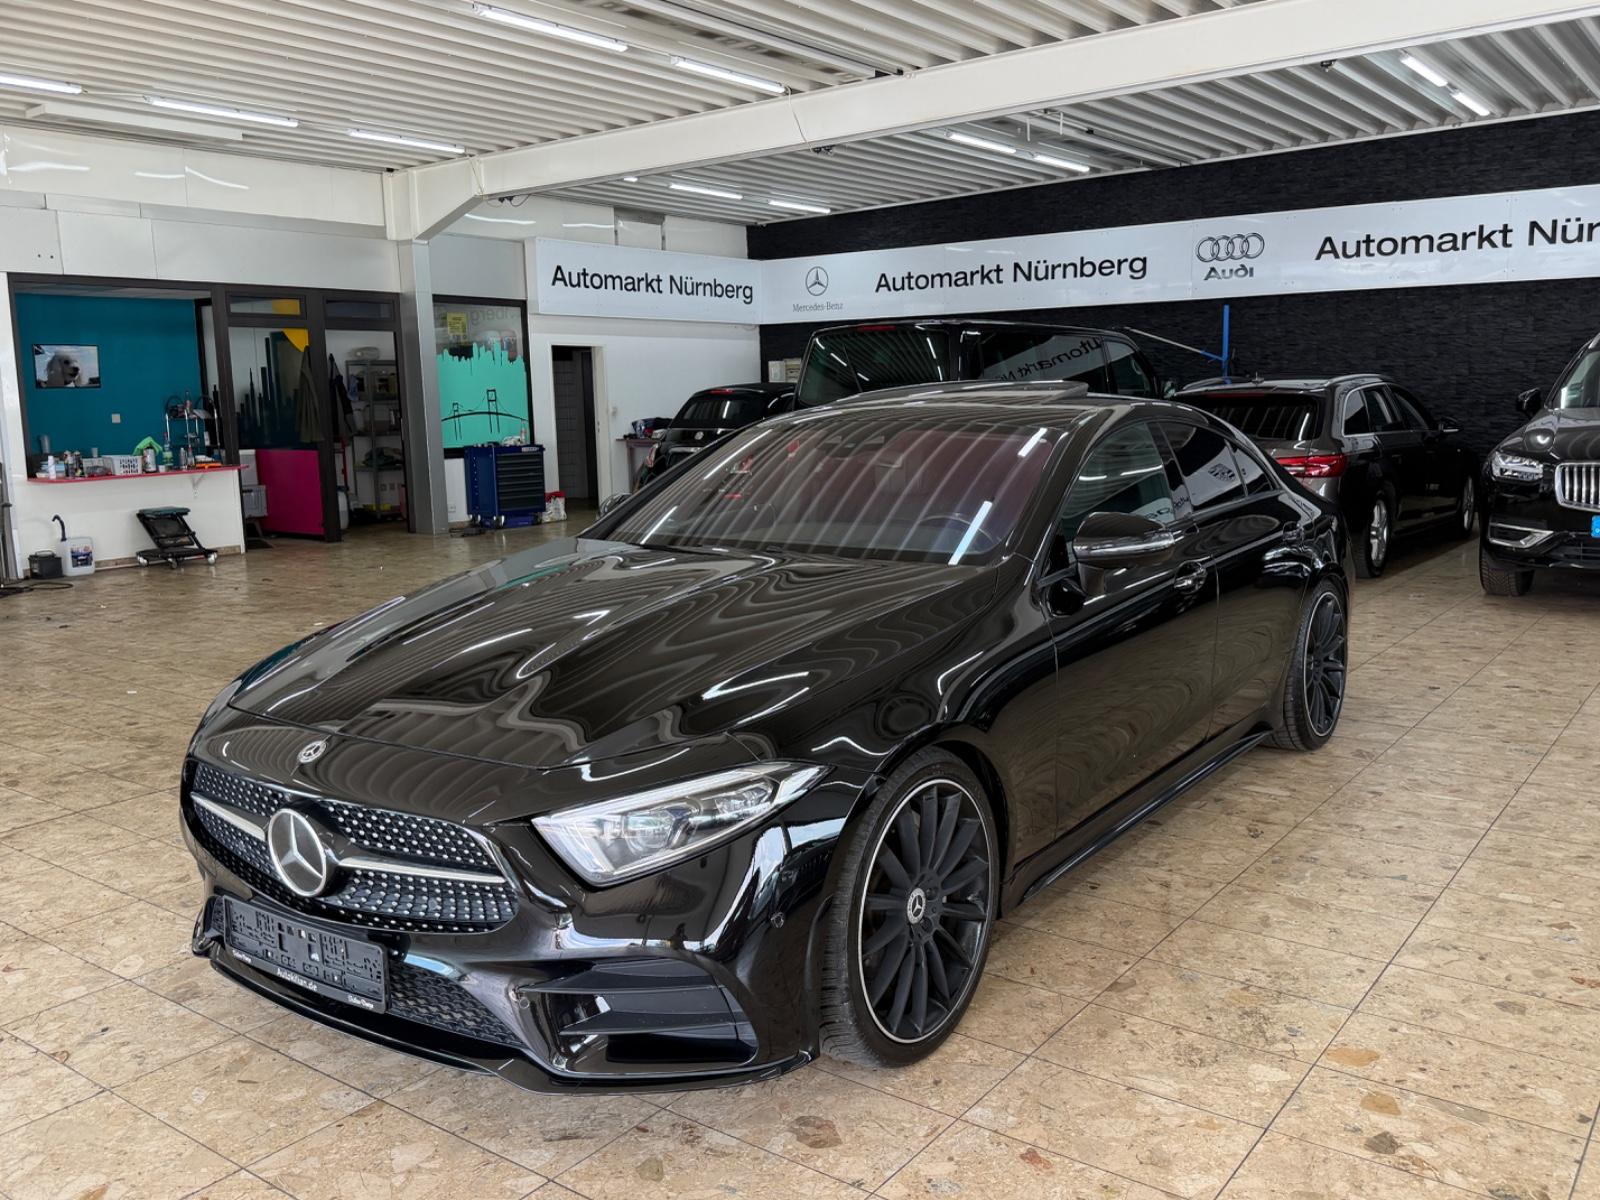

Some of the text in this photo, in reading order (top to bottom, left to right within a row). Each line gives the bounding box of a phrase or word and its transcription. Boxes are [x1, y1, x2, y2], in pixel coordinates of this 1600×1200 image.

[1314, 223, 1514, 261] Automarkt
[551, 264, 753, 305] Automarkt Nürnberg
[875, 255, 1148, 293] Automarkt Nürnberg
[1203, 263, 1254, 281] Audi
[792, 301, 844, 313] Mercedes-Benz
